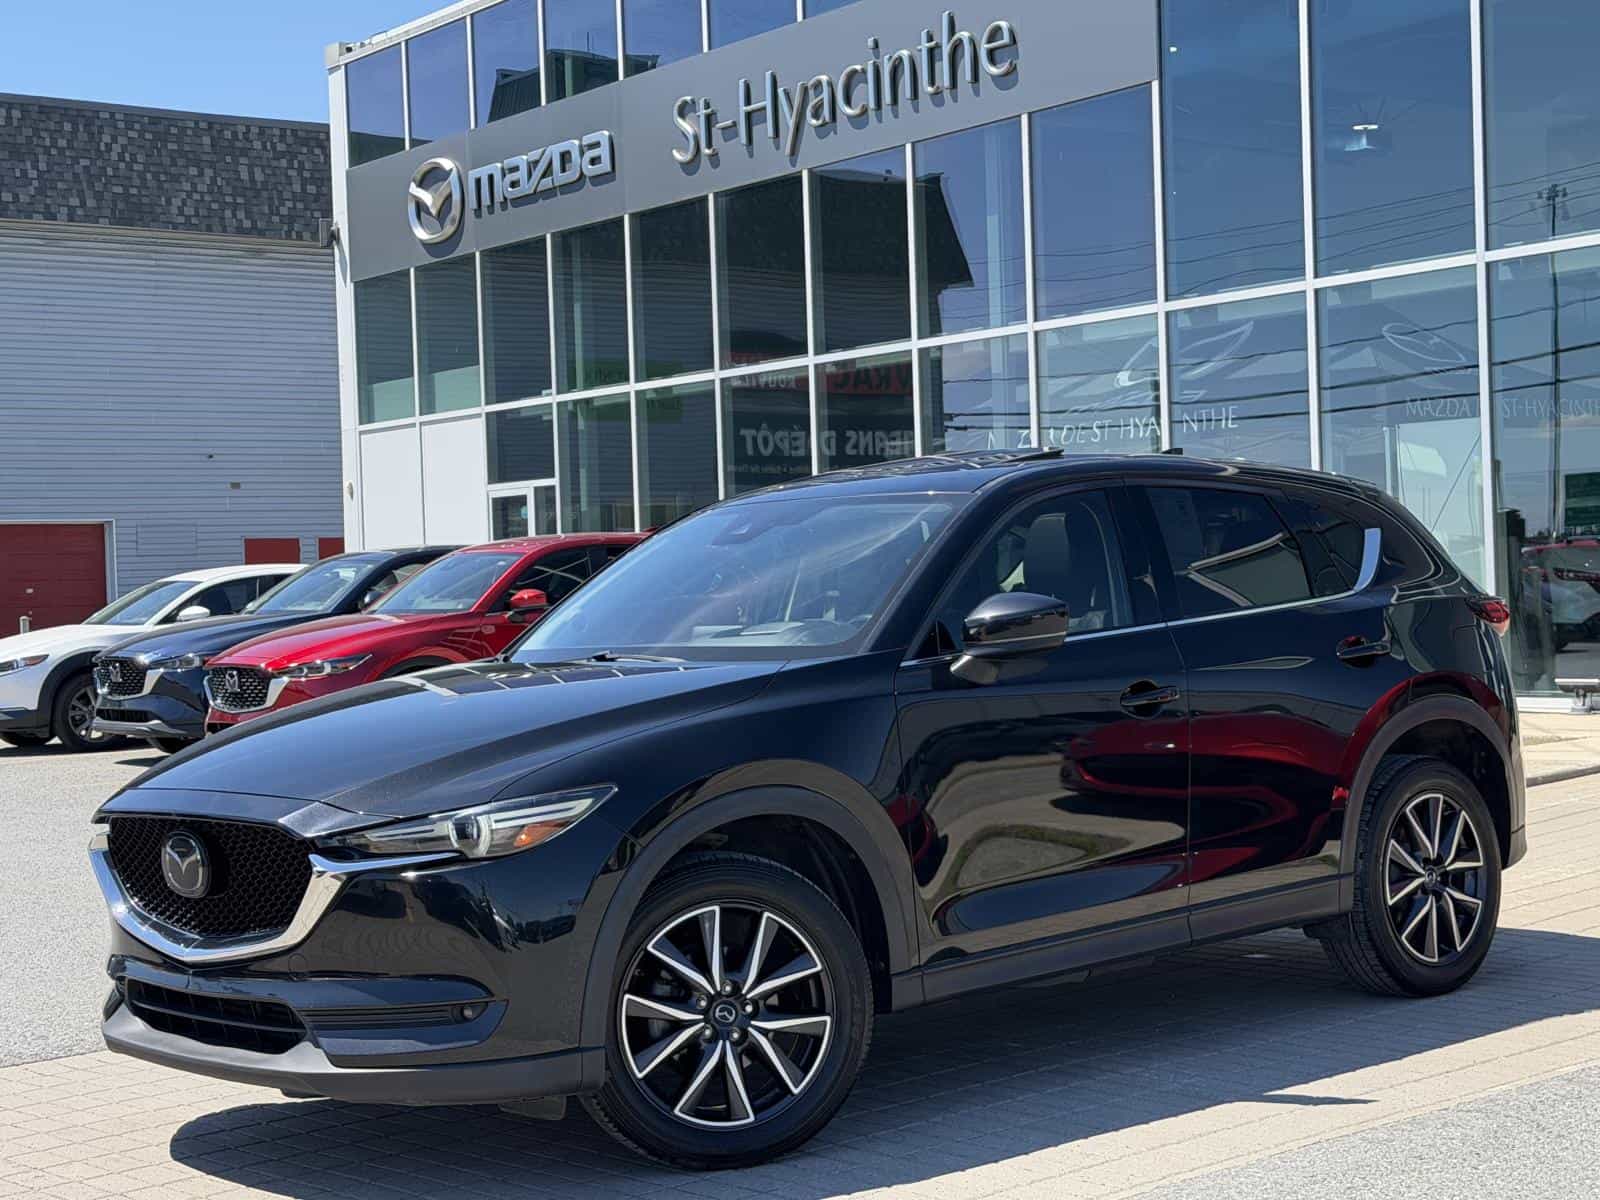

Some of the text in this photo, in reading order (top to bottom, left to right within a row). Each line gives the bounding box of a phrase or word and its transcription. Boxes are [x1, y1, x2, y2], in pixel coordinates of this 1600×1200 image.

[468, 9, 1018, 211] mazda St-Hyacinthe
[1405, 399, 1472, 418] MAZDA
